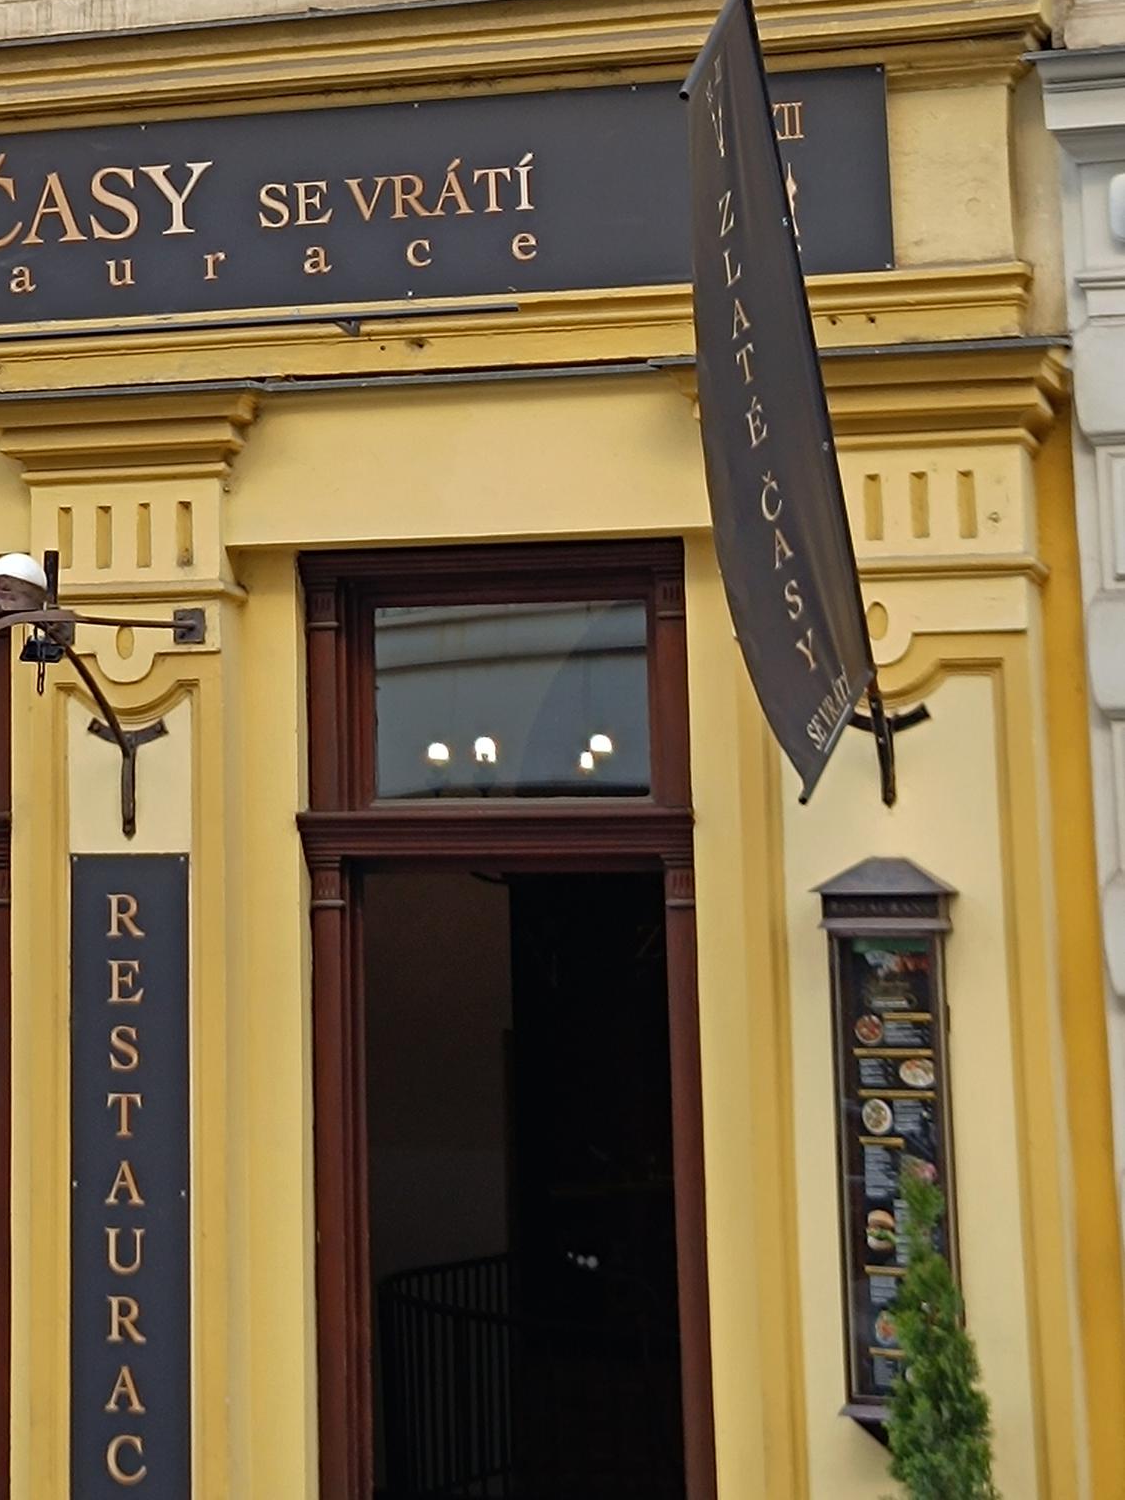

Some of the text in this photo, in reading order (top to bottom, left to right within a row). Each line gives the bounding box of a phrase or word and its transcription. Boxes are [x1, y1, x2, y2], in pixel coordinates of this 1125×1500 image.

[258, 180, 334, 229] SE
[345, 152, 535, 223] VRÁTÍ
[716, 189, 817, 672] ZLATÉ ČASY
[105, 892, 148, 1486] RESTAURAC
